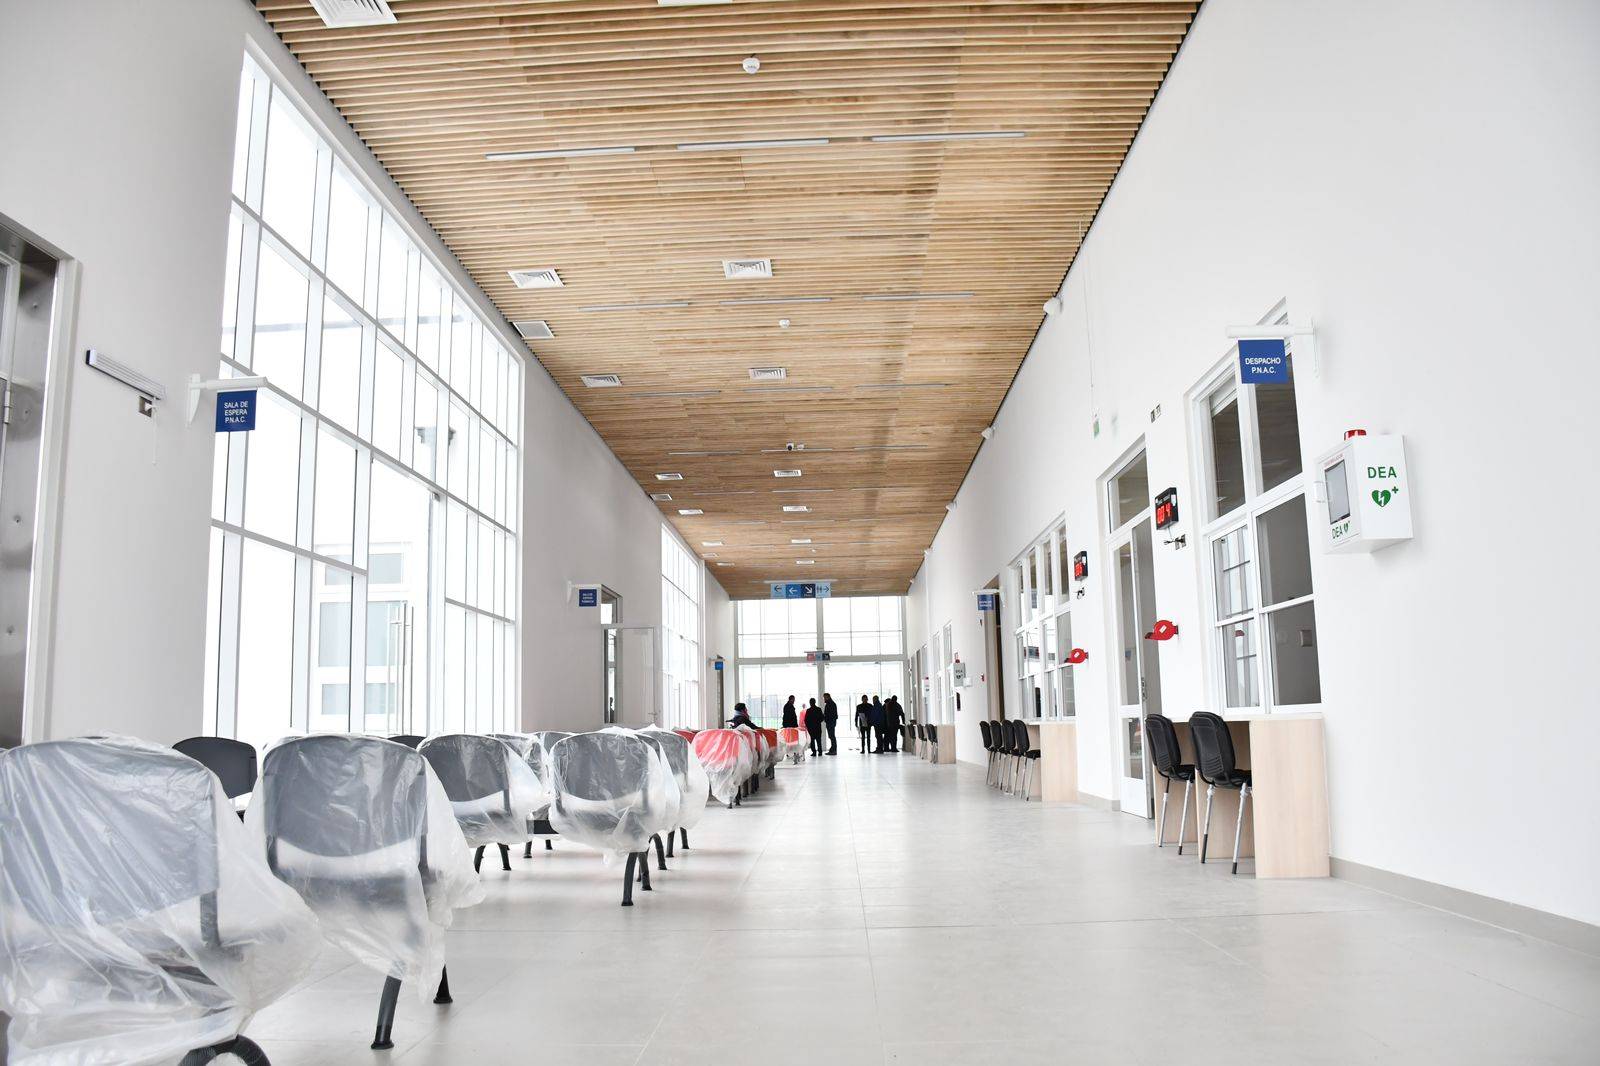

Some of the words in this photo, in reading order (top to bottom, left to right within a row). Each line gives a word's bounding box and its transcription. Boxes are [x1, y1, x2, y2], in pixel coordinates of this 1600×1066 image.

[1245, 357, 1281, 365] DESPACHO
[1251, 366, 1277, 374] P.N.A.C.
[224, 409, 248, 417] ESPERA
[1367, 466, 1397, 478] DEA
[1331, 525, 1344, 539] DEA
